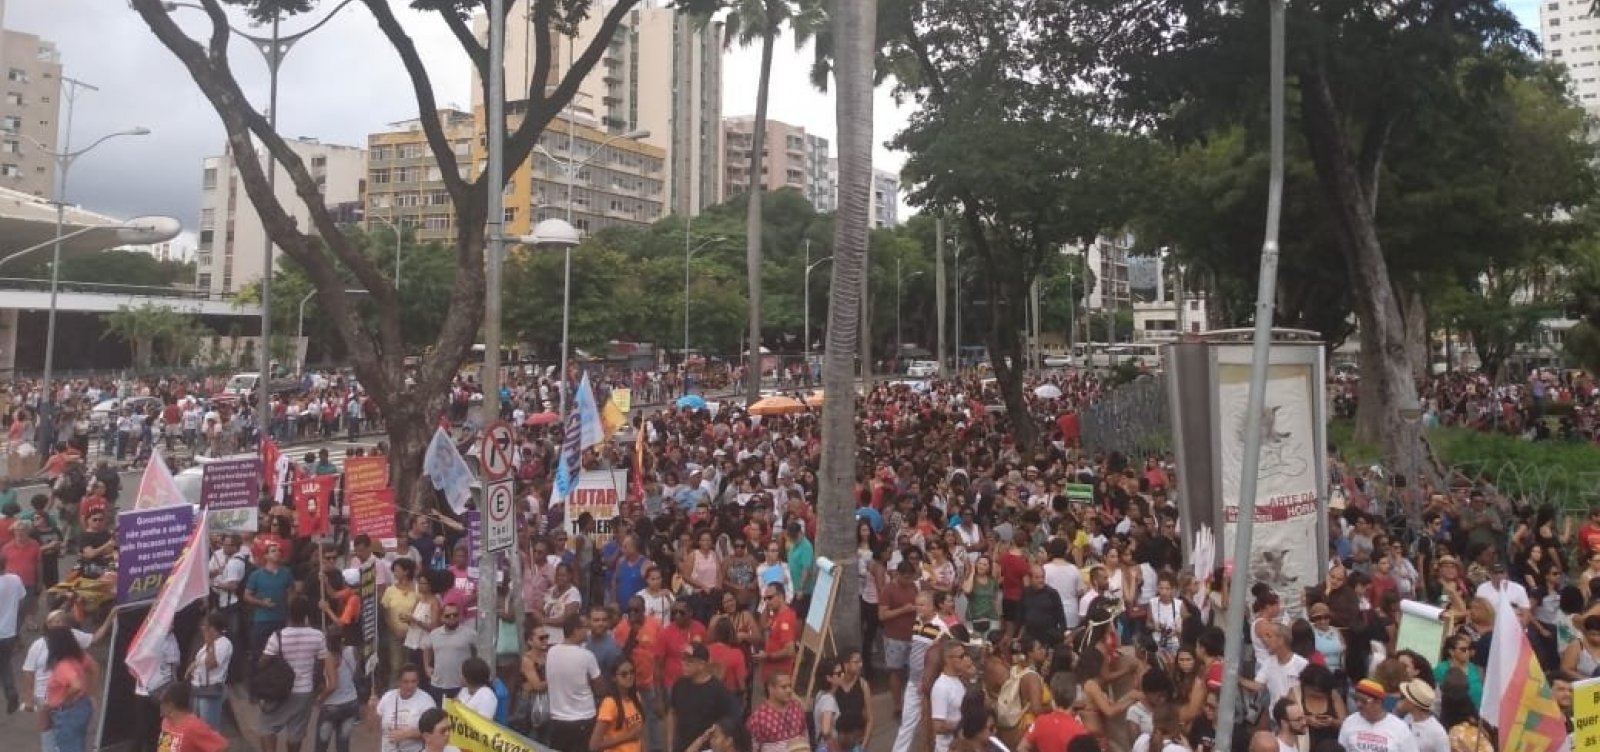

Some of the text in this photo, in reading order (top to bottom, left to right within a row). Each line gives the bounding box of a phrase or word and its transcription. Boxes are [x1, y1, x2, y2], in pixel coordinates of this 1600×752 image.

[496, 493, 505, 513] E
[569, 488, 617, 505] LUTAR
[1270, 495, 1301, 508] ARTE
[1287, 501, 1317, 517] HORA
[571, 520, 612, 534] TER
[1576, 714, 1598, 731] quer
